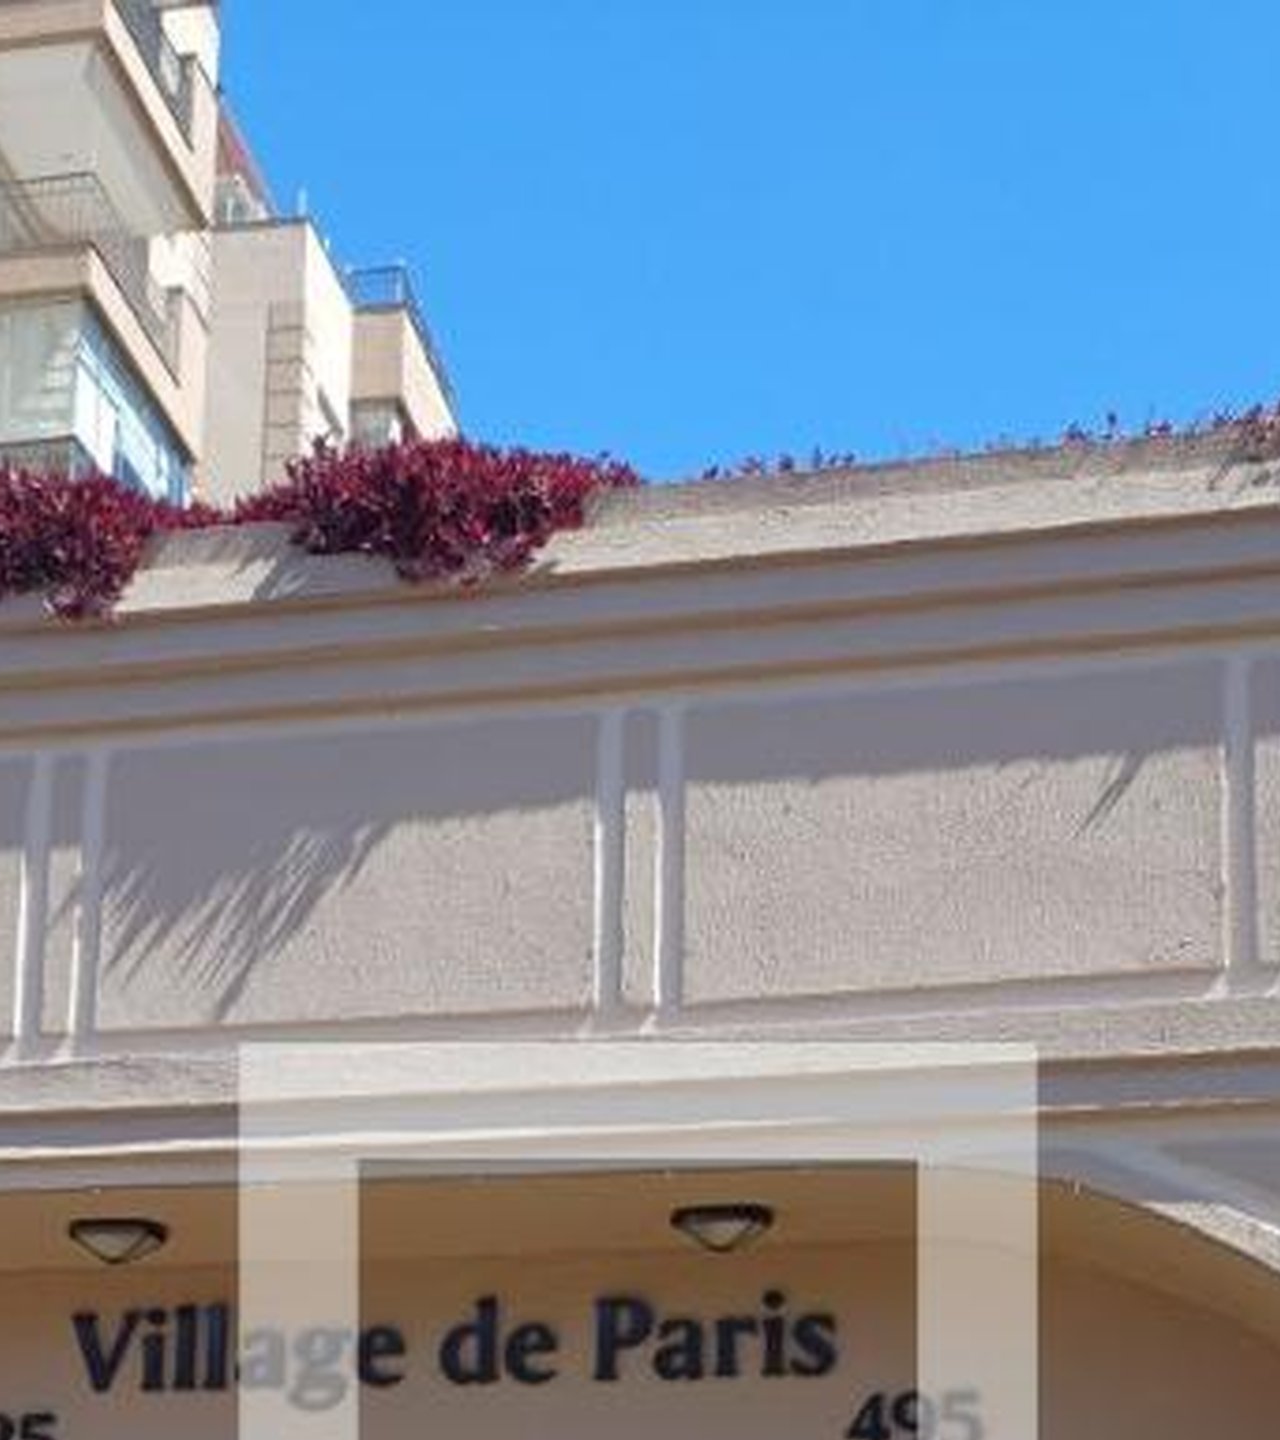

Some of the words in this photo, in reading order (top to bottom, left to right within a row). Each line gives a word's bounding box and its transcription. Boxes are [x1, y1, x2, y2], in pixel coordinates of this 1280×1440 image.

[72, 1301, 406, 1411] Village
[439, 1297, 559, 1385] de
[593, 1289, 838, 1382] Paris
